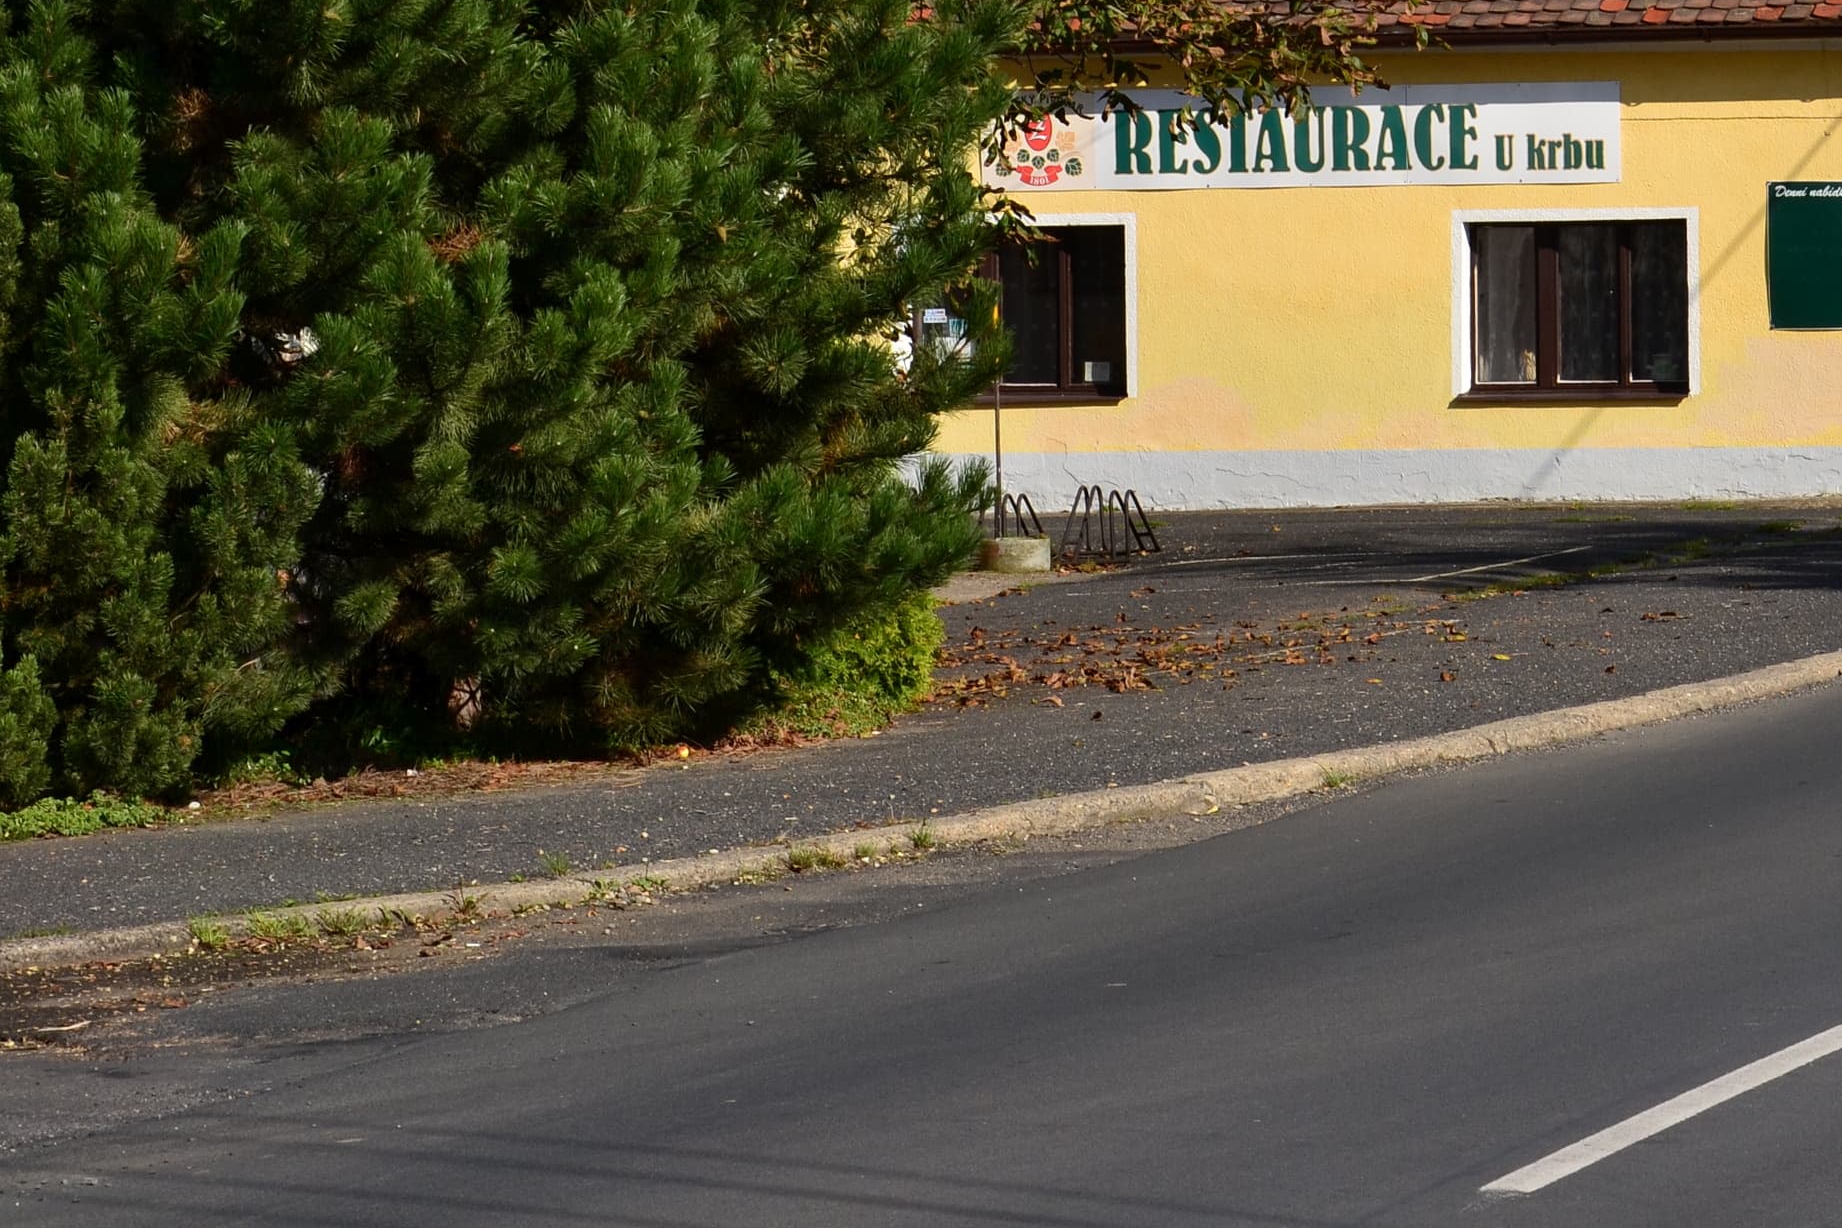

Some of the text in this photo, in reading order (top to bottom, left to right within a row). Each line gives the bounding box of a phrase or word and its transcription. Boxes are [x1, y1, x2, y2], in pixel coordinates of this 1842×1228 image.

[1114, 103, 1605, 175] RESTAURACE U krbu
[1030, 175, 1050, 185] 1801
